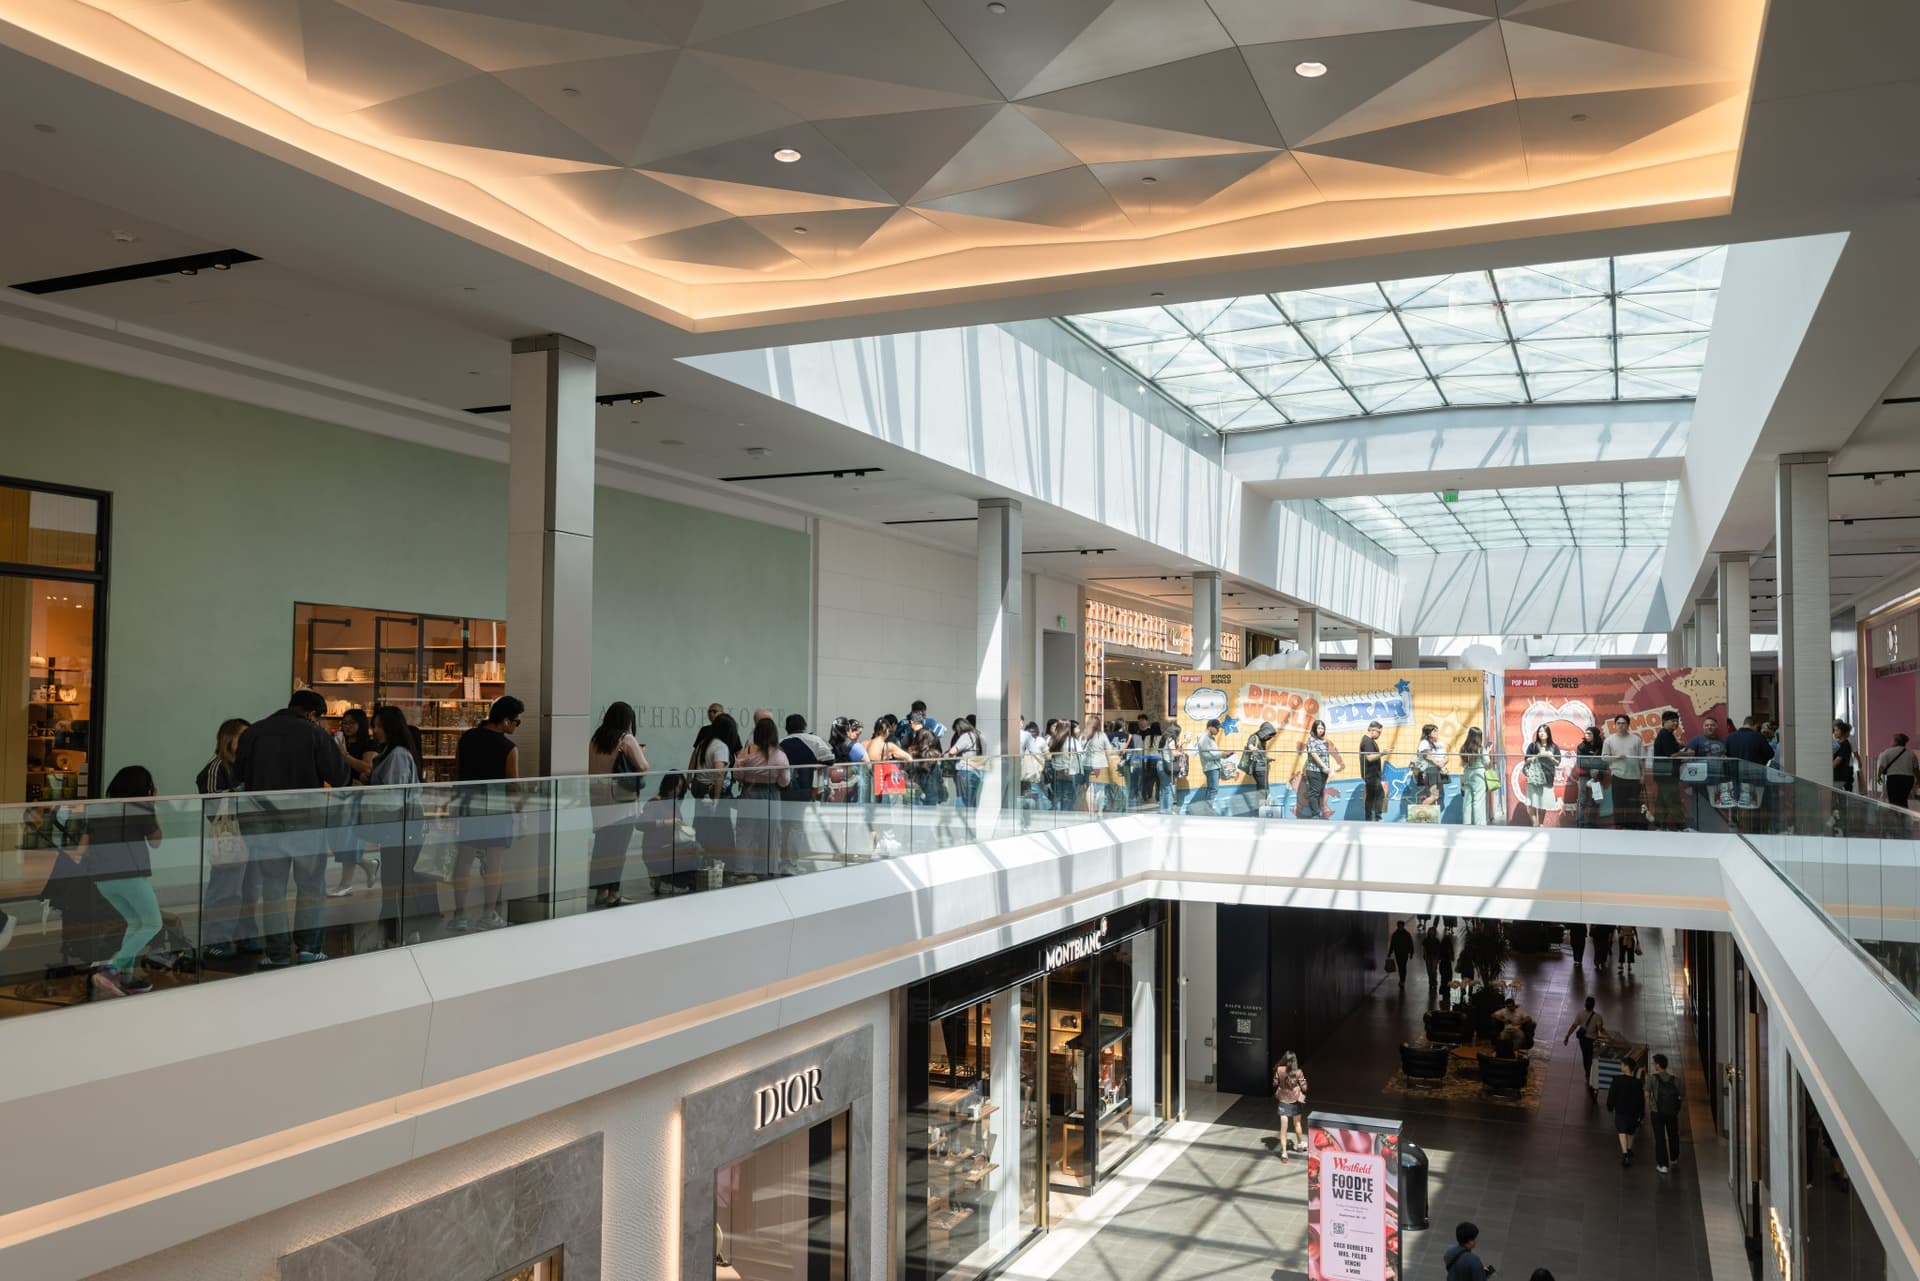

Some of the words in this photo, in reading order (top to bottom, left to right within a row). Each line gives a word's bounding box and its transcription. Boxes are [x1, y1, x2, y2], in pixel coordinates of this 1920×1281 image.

[1248, 684, 1320, 715] DIMOO
[1328, 699, 1407, 724] PIXAR
[1045, 932, 1101, 971] MONTBLANC
[755, 1067, 824, 1129] DIOR
[1333, 1157, 1372, 1174] Westfield
[1332, 1173, 1373, 1192] FOODIE
[1332, 1188, 1373, 1203] WEEK
